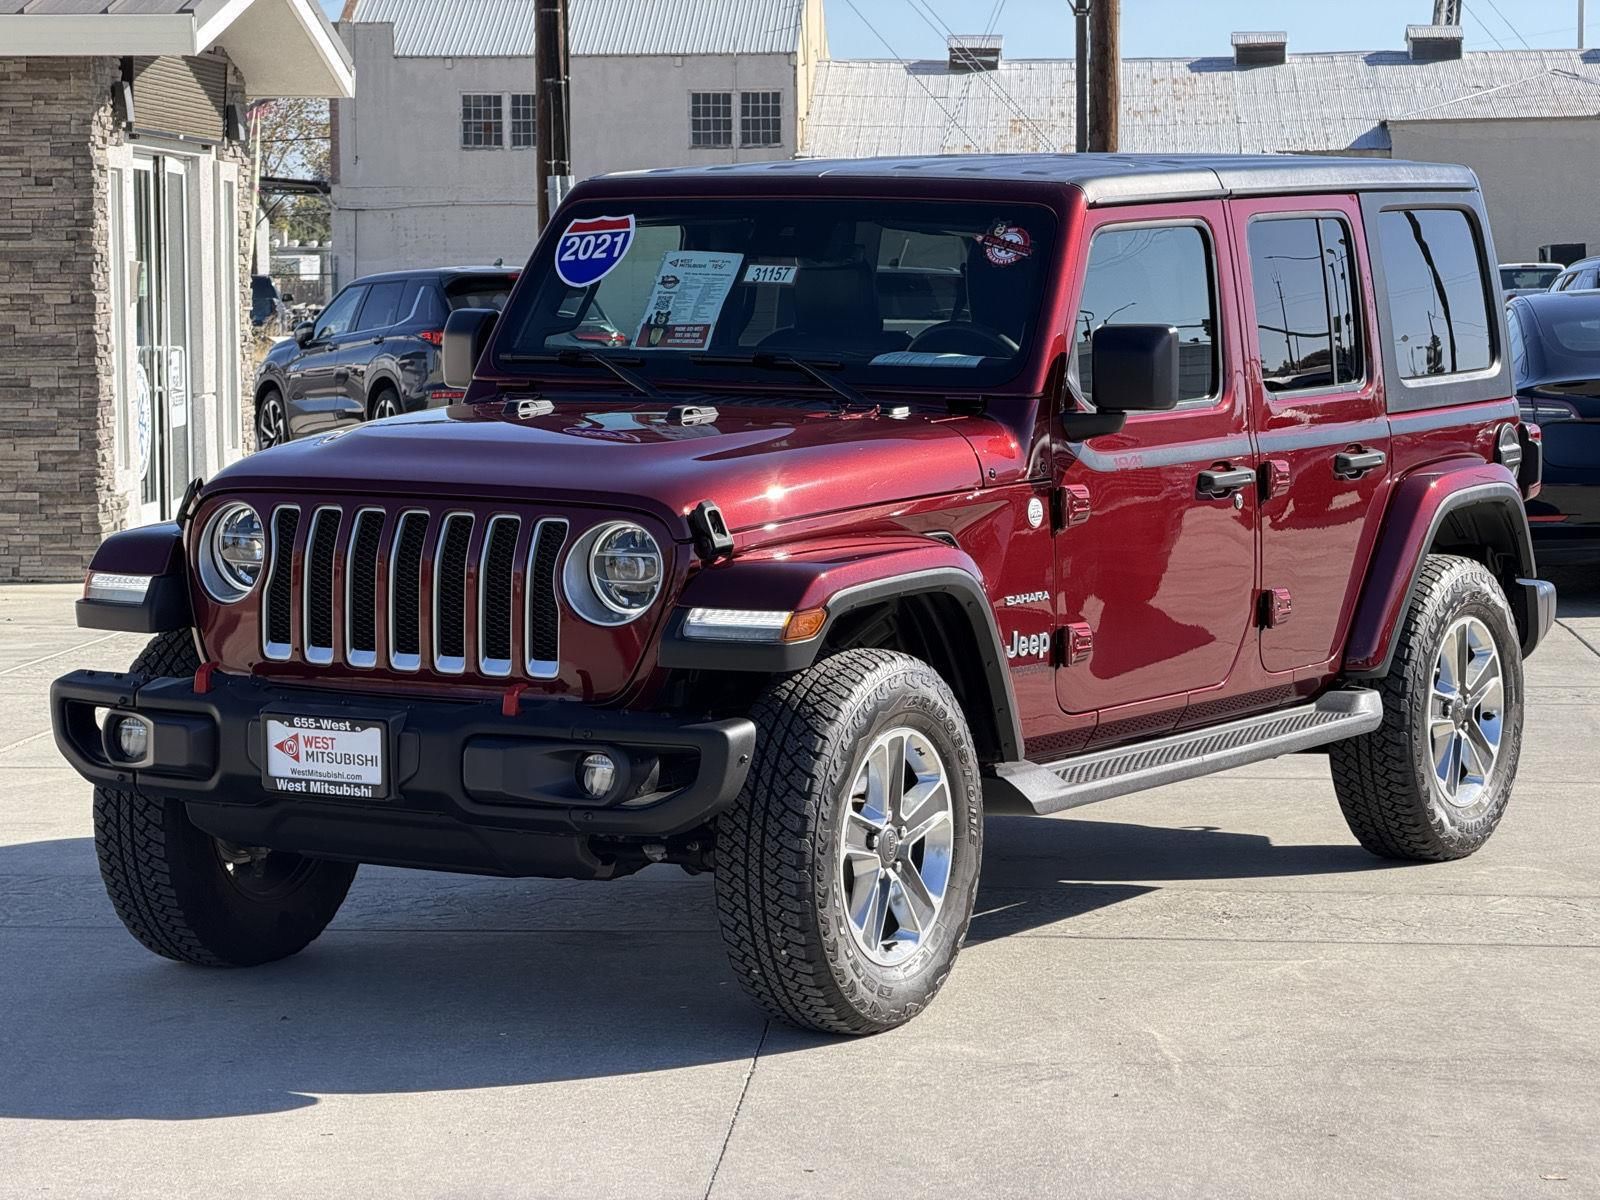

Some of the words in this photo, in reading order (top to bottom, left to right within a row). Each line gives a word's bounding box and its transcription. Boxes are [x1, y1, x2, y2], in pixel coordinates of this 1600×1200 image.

[560, 232, 626, 262] 2021
[752, 267, 791, 282] 31157
[1004, 590, 1050, 606] SAHARA
[1005, 630, 1051, 659] Jeep
[293, 717, 351, 731] 655-West
[302, 735, 336, 750] WEST
[305, 750, 378, 767] MITSUBISHI
[290, 768, 363, 781] WestMitsubishi.com
[276, 779, 306, 792] West
[310, 781, 372, 798] Mitsubishi
